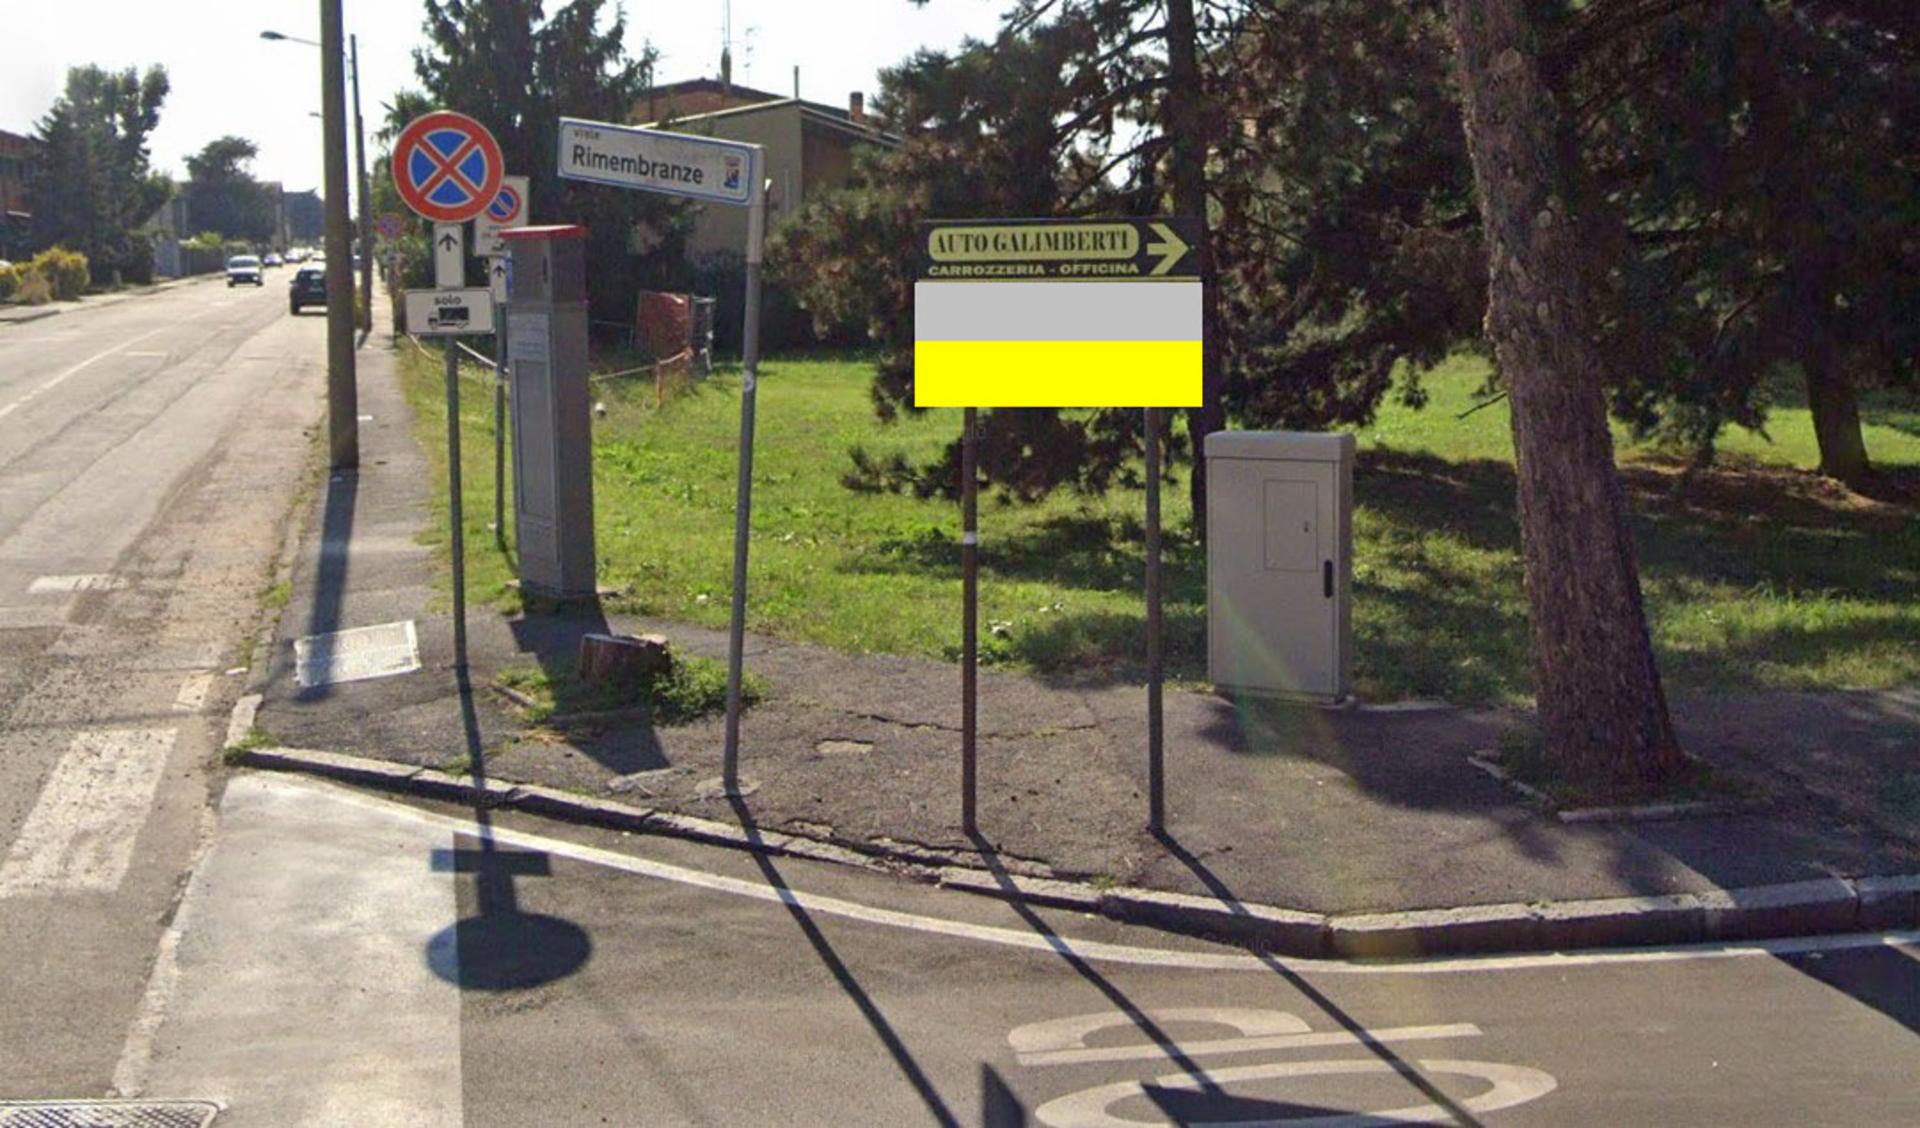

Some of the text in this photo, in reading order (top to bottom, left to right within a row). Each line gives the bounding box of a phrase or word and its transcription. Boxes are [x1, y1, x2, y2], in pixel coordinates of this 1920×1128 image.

[572, 144, 704, 184] Rimembranze
[936, 230, 1129, 253] AUTO GALIMBERTI
[928, 264, 1046, 276] CARROZZERIA
[1059, 263, 1140, 275] OFFICINA
[434, 294, 462, 305] solo
